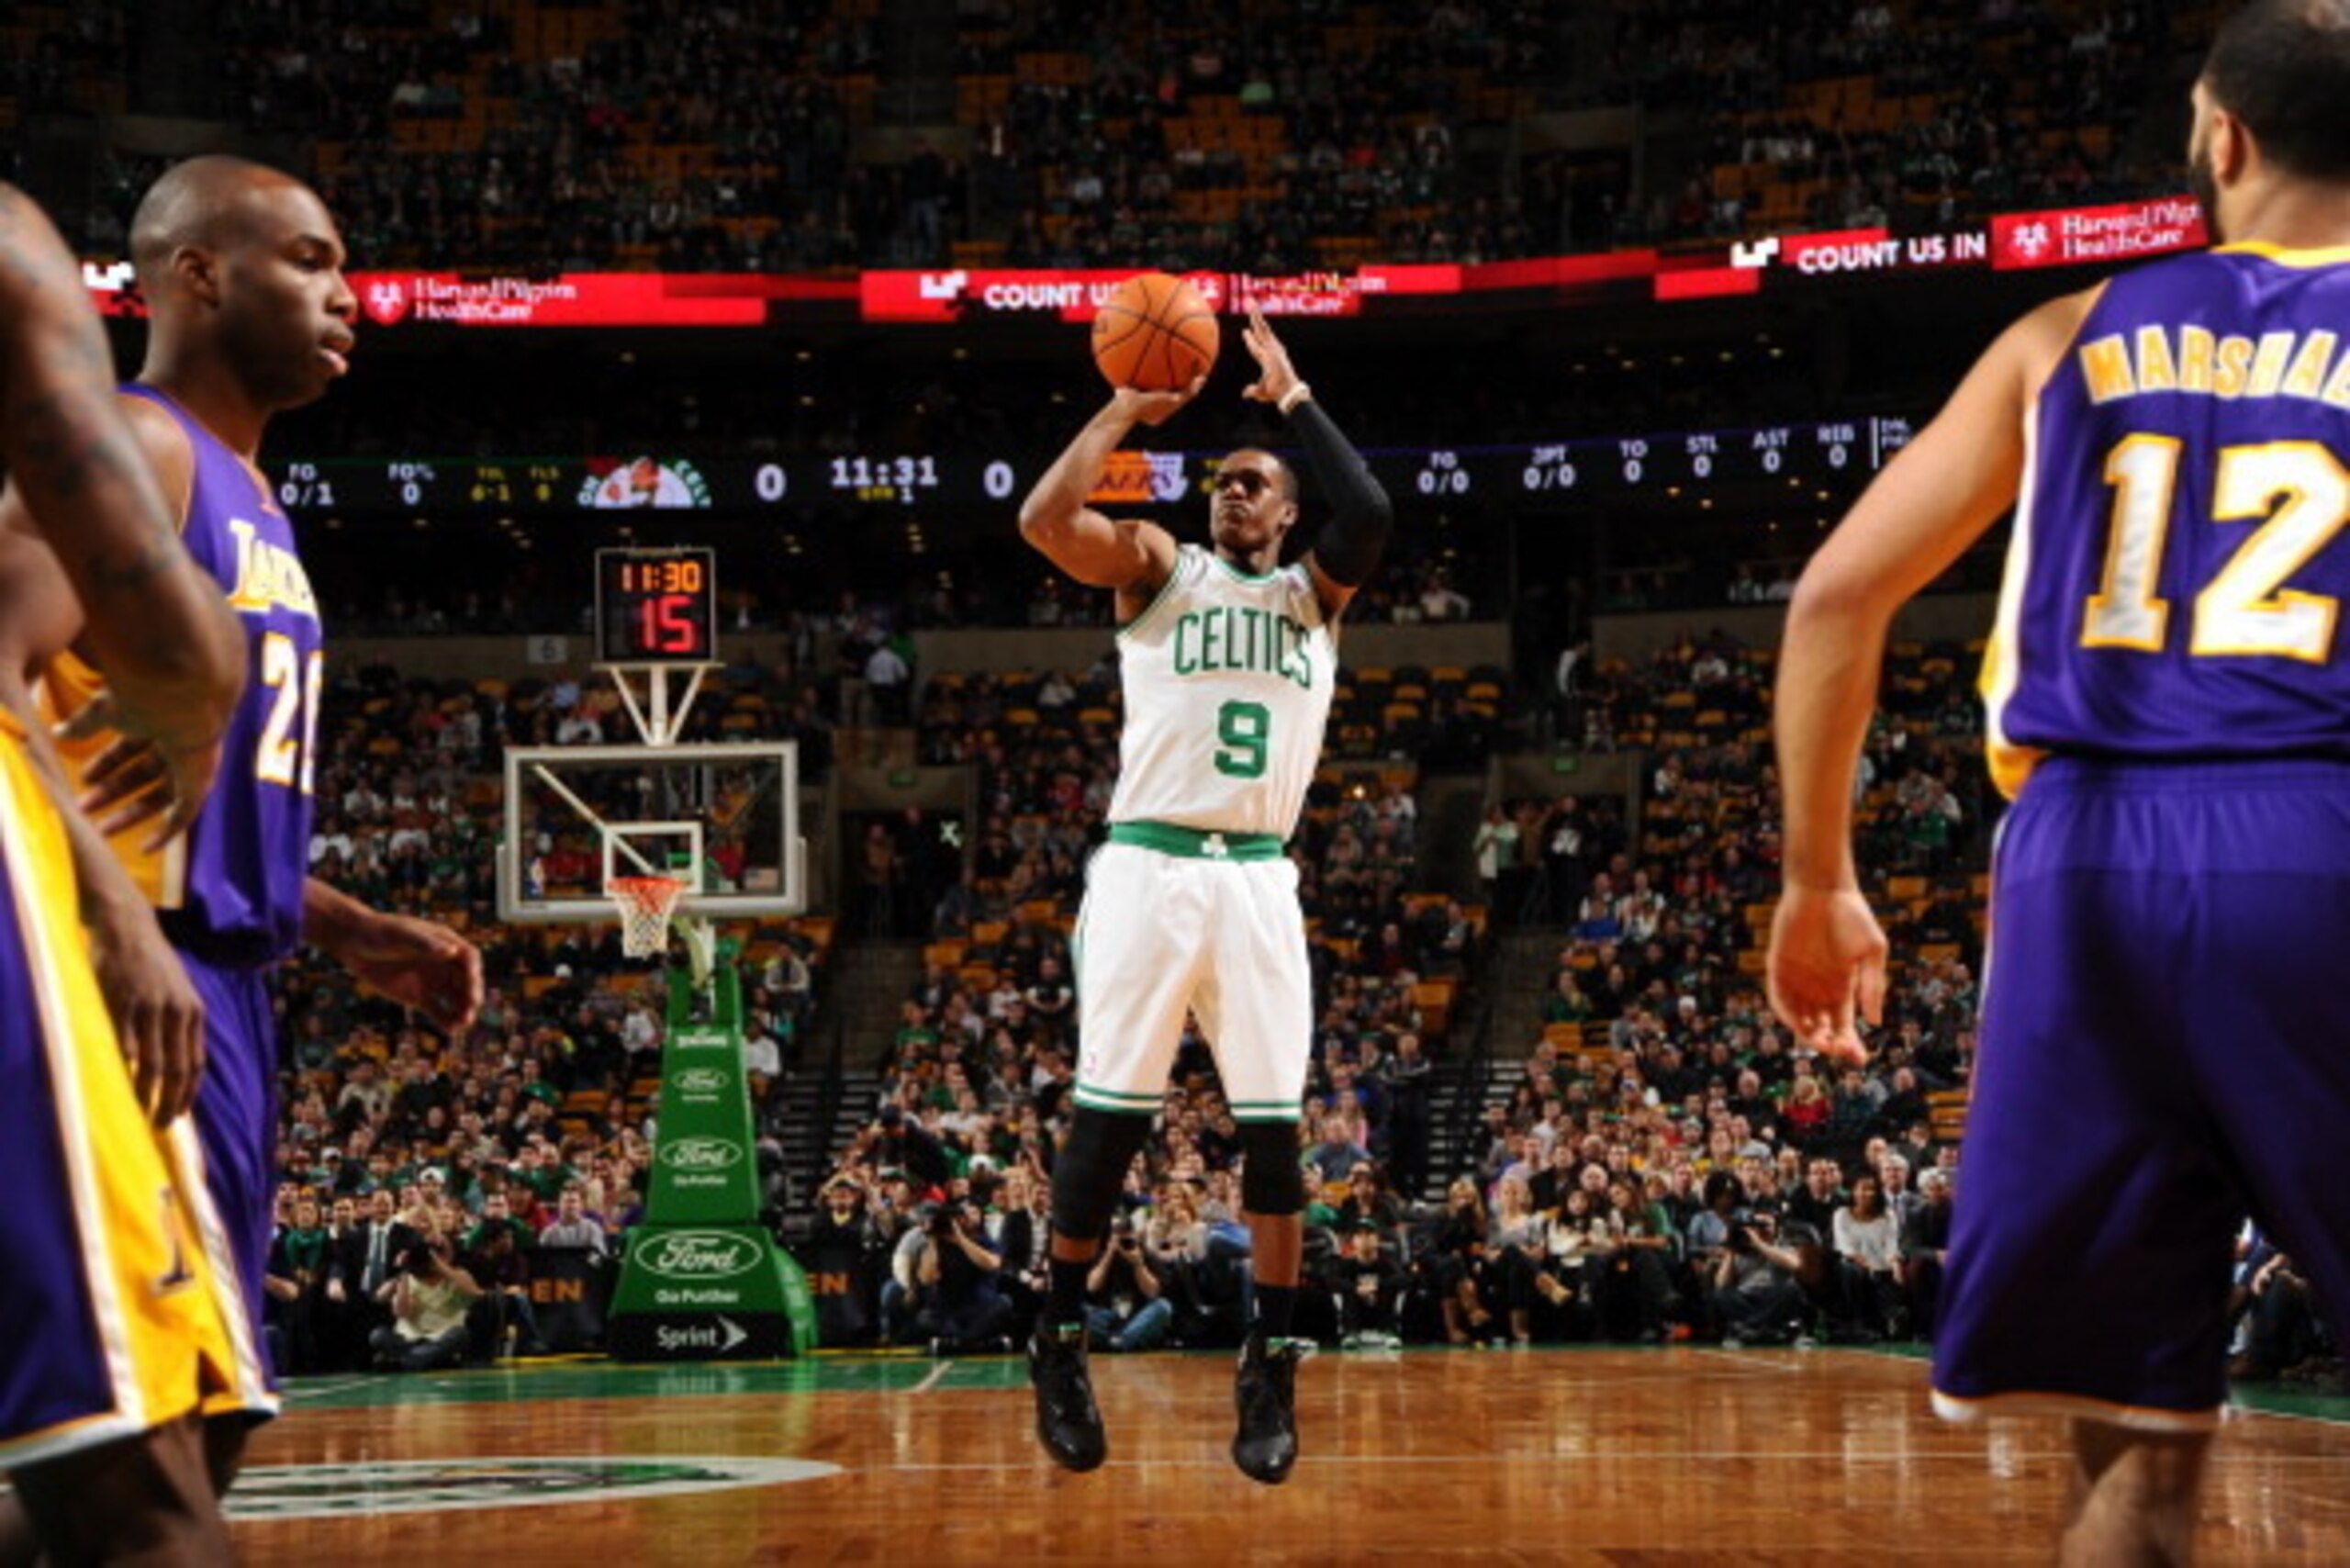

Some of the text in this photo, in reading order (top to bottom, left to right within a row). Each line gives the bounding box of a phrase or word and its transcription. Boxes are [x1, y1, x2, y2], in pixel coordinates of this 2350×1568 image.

[1797, 232, 1986, 273] COUNT US IN
[984, 282, 1083, 309] COUNT
[1619, 439, 1649, 458] TO
[1752, 428, 1790, 448] AST
[831, 454, 939, 487] 11:31
[1624, 459, 1643, 482] 0
[1694, 454, 1712, 477] 0
[1763, 449, 1781, 472] 0
[1829, 444, 1847, 468] 0
[401, 482, 421, 506] 0
[755, 465, 786, 501] 0
[983, 462, 1014, 498] 0
[2080, 432, 2350, 666] 12
[621, 561, 700, 592] 11:30
[642, 595, 694, 653] 15
[1174, 606, 1310, 690] CELTICS
[1214, 700, 1270, 778] 9
[674, 1141, 727, 1167] Ford
[657, 1238, 739, 1271] Ford
[656, 1325, 717, 1350] Sprint
